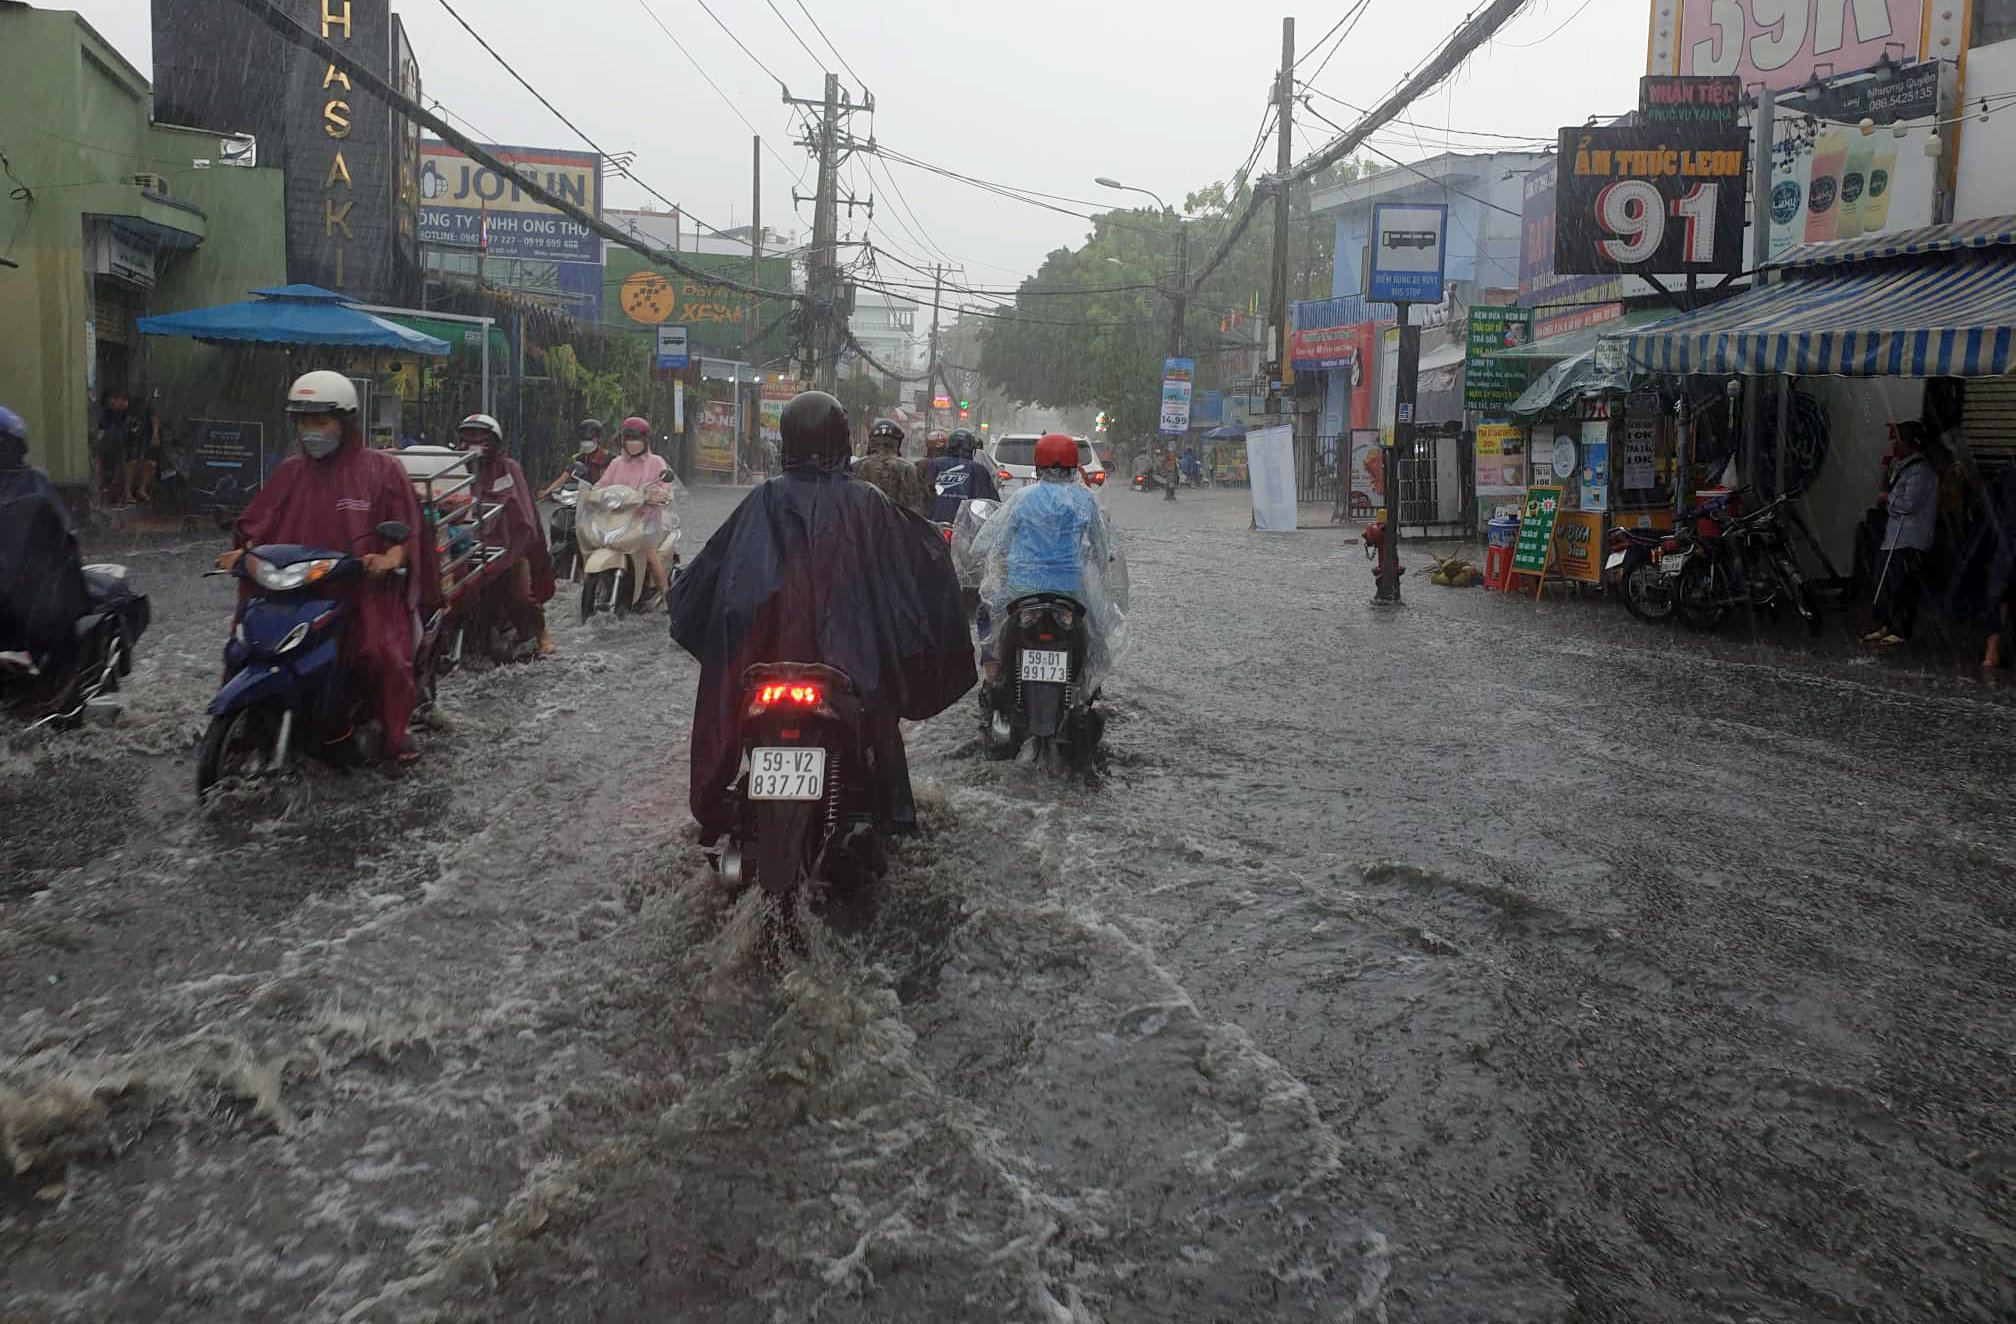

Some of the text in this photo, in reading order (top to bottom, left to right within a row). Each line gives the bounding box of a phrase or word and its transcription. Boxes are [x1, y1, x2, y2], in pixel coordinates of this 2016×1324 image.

[1679, 150, 1744, 176] LEON
[419, 209, 451, 227] ÔNG
[455, 213, 473, 228] TY
[478, 216, 518, 232] NHH
[522, 220, 556, 235] ONG
[1594, 179, 1719, 265] 91
[1023, 666, 1065, 680] 991.73
[754, 775, 818, 796] 837.70
